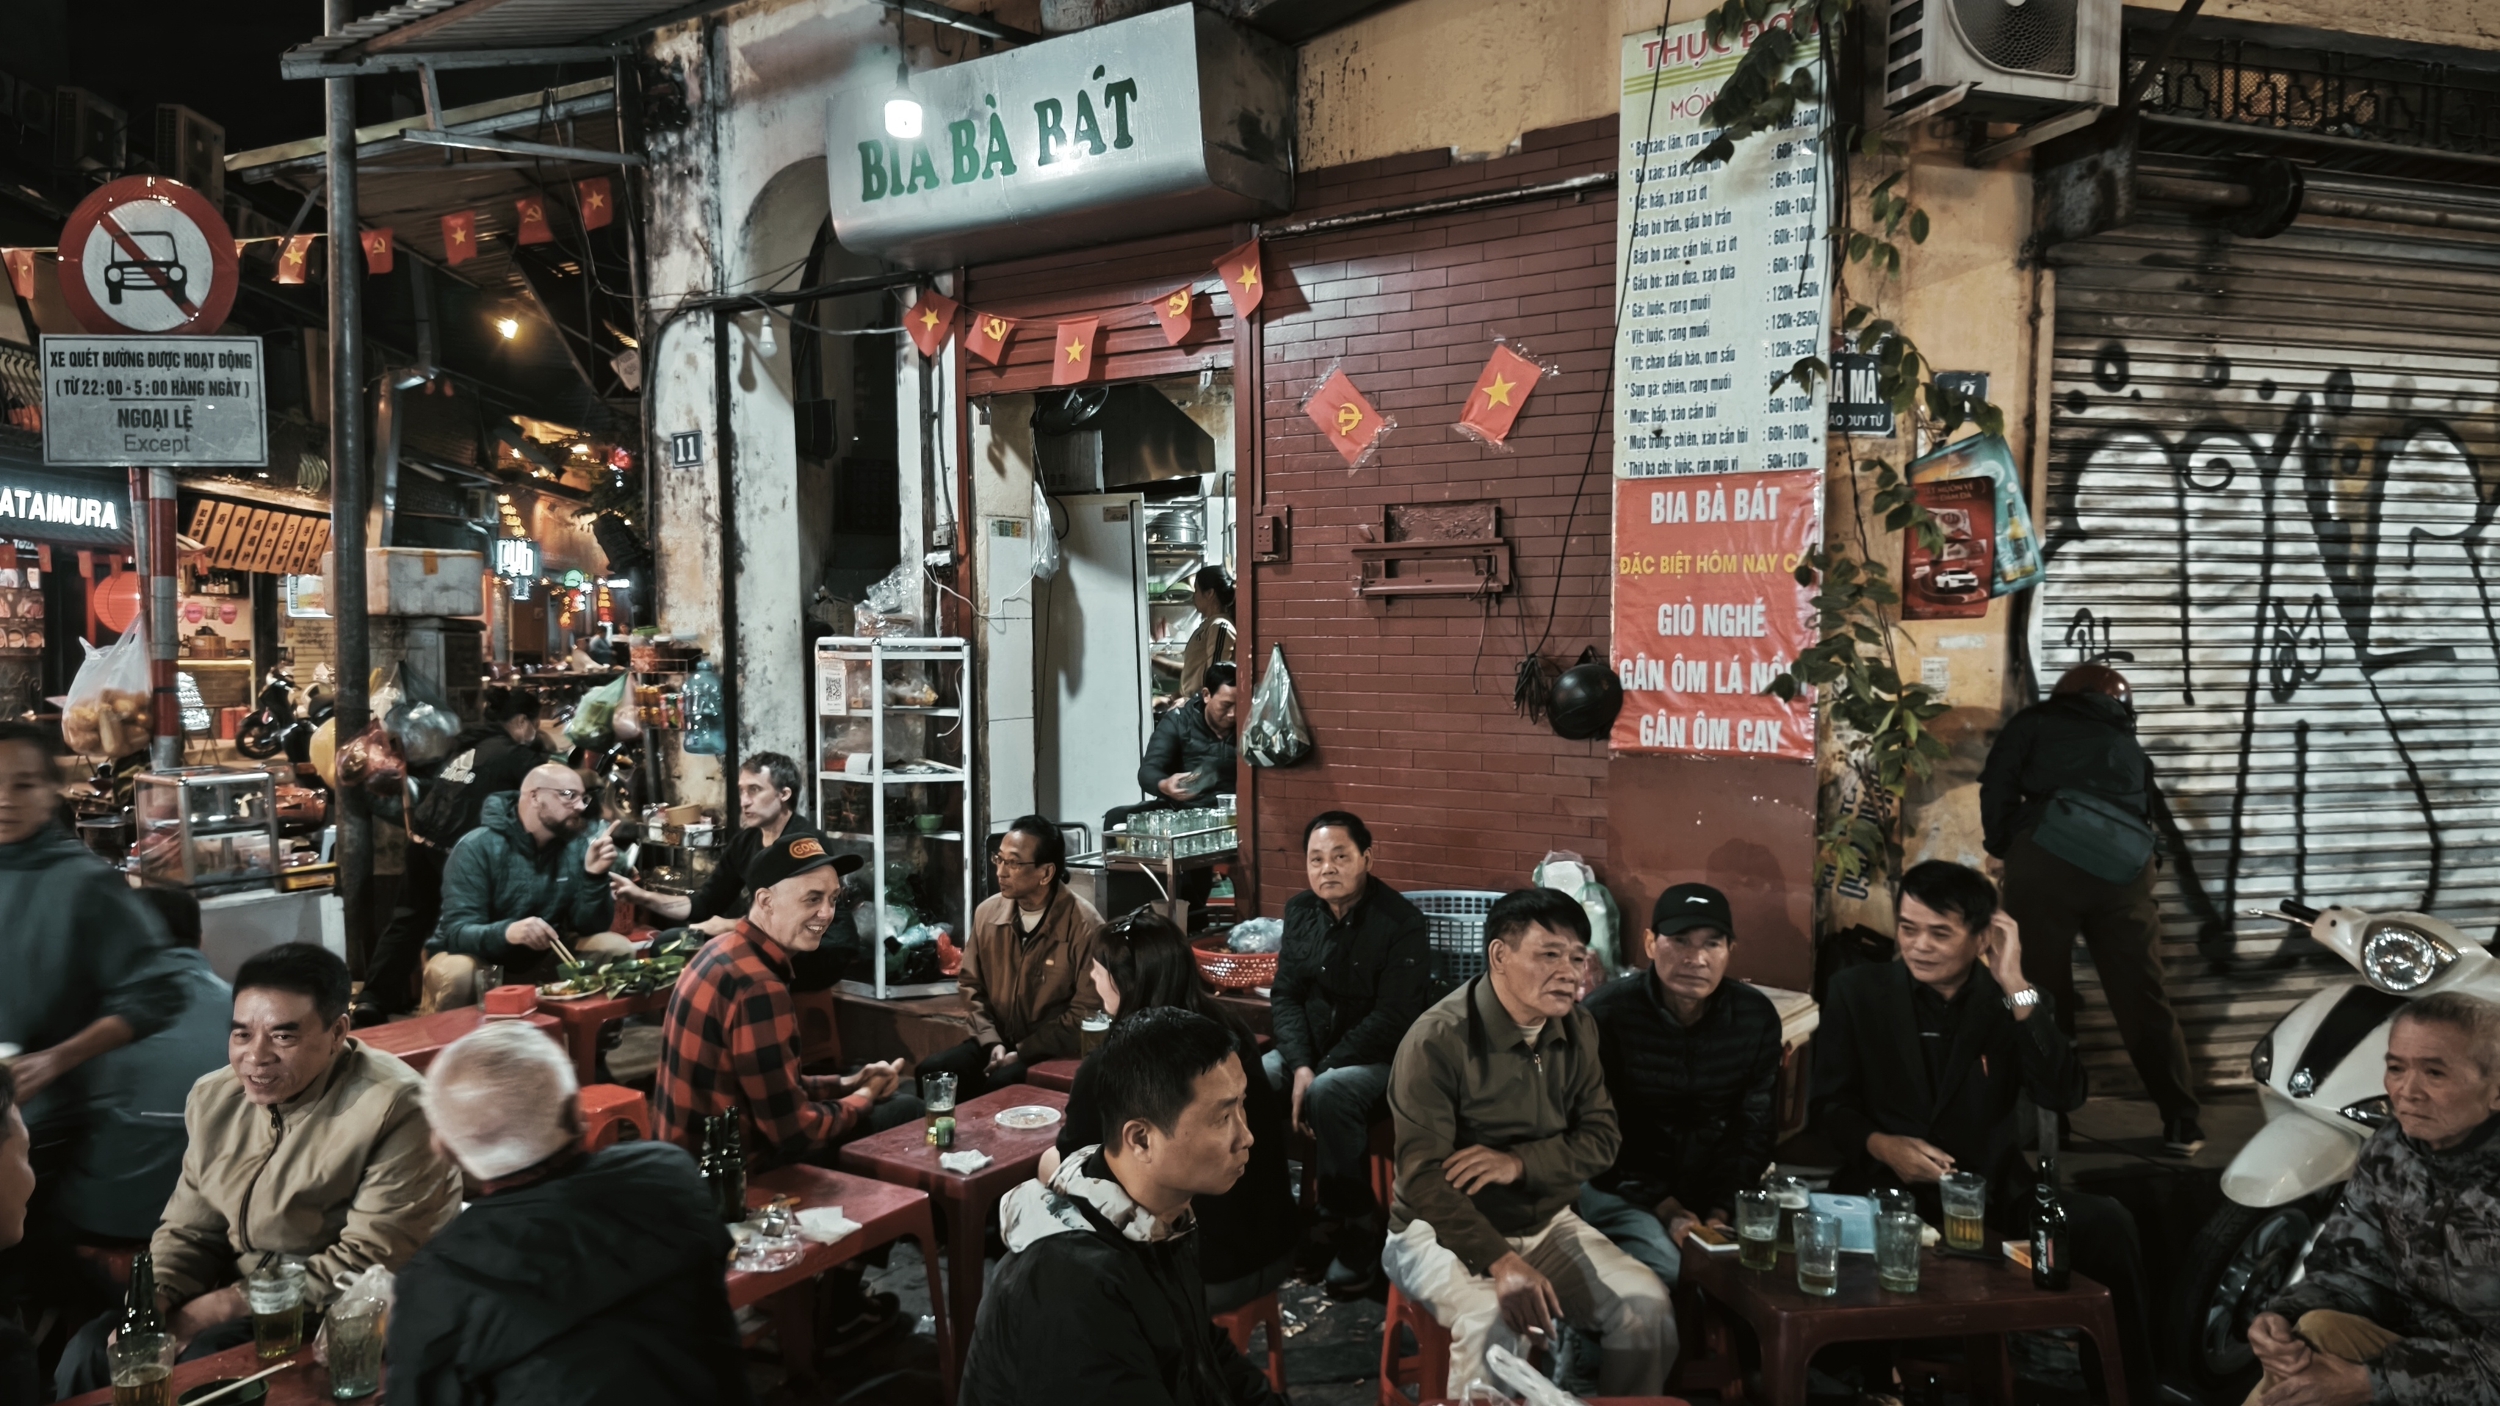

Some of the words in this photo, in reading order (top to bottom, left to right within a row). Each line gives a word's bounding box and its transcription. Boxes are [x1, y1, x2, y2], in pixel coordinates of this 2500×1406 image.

[1741, 8, 1819, 49] ĐƠ
[857, 138, 940, 202] BIA
[949, 93, 1018, 185] BÀ
[1034, 64, 1137, 167] BÁT
[1669, 299, 1687, 314] rang
[1669, 327, 1687, 341] rang
[50, 351, 65, 368] XE
[69, 347, 99, 368] QUÉT
[103, 347, 144, 369] ĐƯỜNG
[148, 351, 180, 371] ĐƯỢC
[184, 351, 215, 372] HOẠT
[218, 349, 253, 373] ĐỘNG
[1705, 351, 1717, 364] om
[171, 375, 205, 397] HÀNG
[1689, 379, 1708, 393] rang
[1850, 361, 1884, 404] MÂ
[117, 408, 169, 433] NGOẠI
[174, 404, 193, 433] LỆ
[124, 434, 191, 456] Except
[677, 437, 697, 463] 11
[1650, 490, 1689, 525] BIA
[1695, 482, 1728, 523] BÀ
[1734, 480, 1781, 523] BÁT
[1619, 551, 1655, 580] ĐẶC
[1660, 550, 1692, 579] BIỆT
[1696, 549, 1737, 574] HÔM
[1743, 553, 1778, 574] NAY
[1783, 553, 1801, 573] C
[1657, 595, 1695, 636] GIÒ
[1702, 596, 1766, 638] NGHÉ
[1619, 652, 1664, 692] GÂN
[1671, 653, 1707, 693] ÔM
[1714, 654, 1743, 695] LÁ
[1639, 708, 1686, 749] GÂN
[1693, 711, 1730, 751] ÔM
[1737, 718, 1782, 754] CAY
